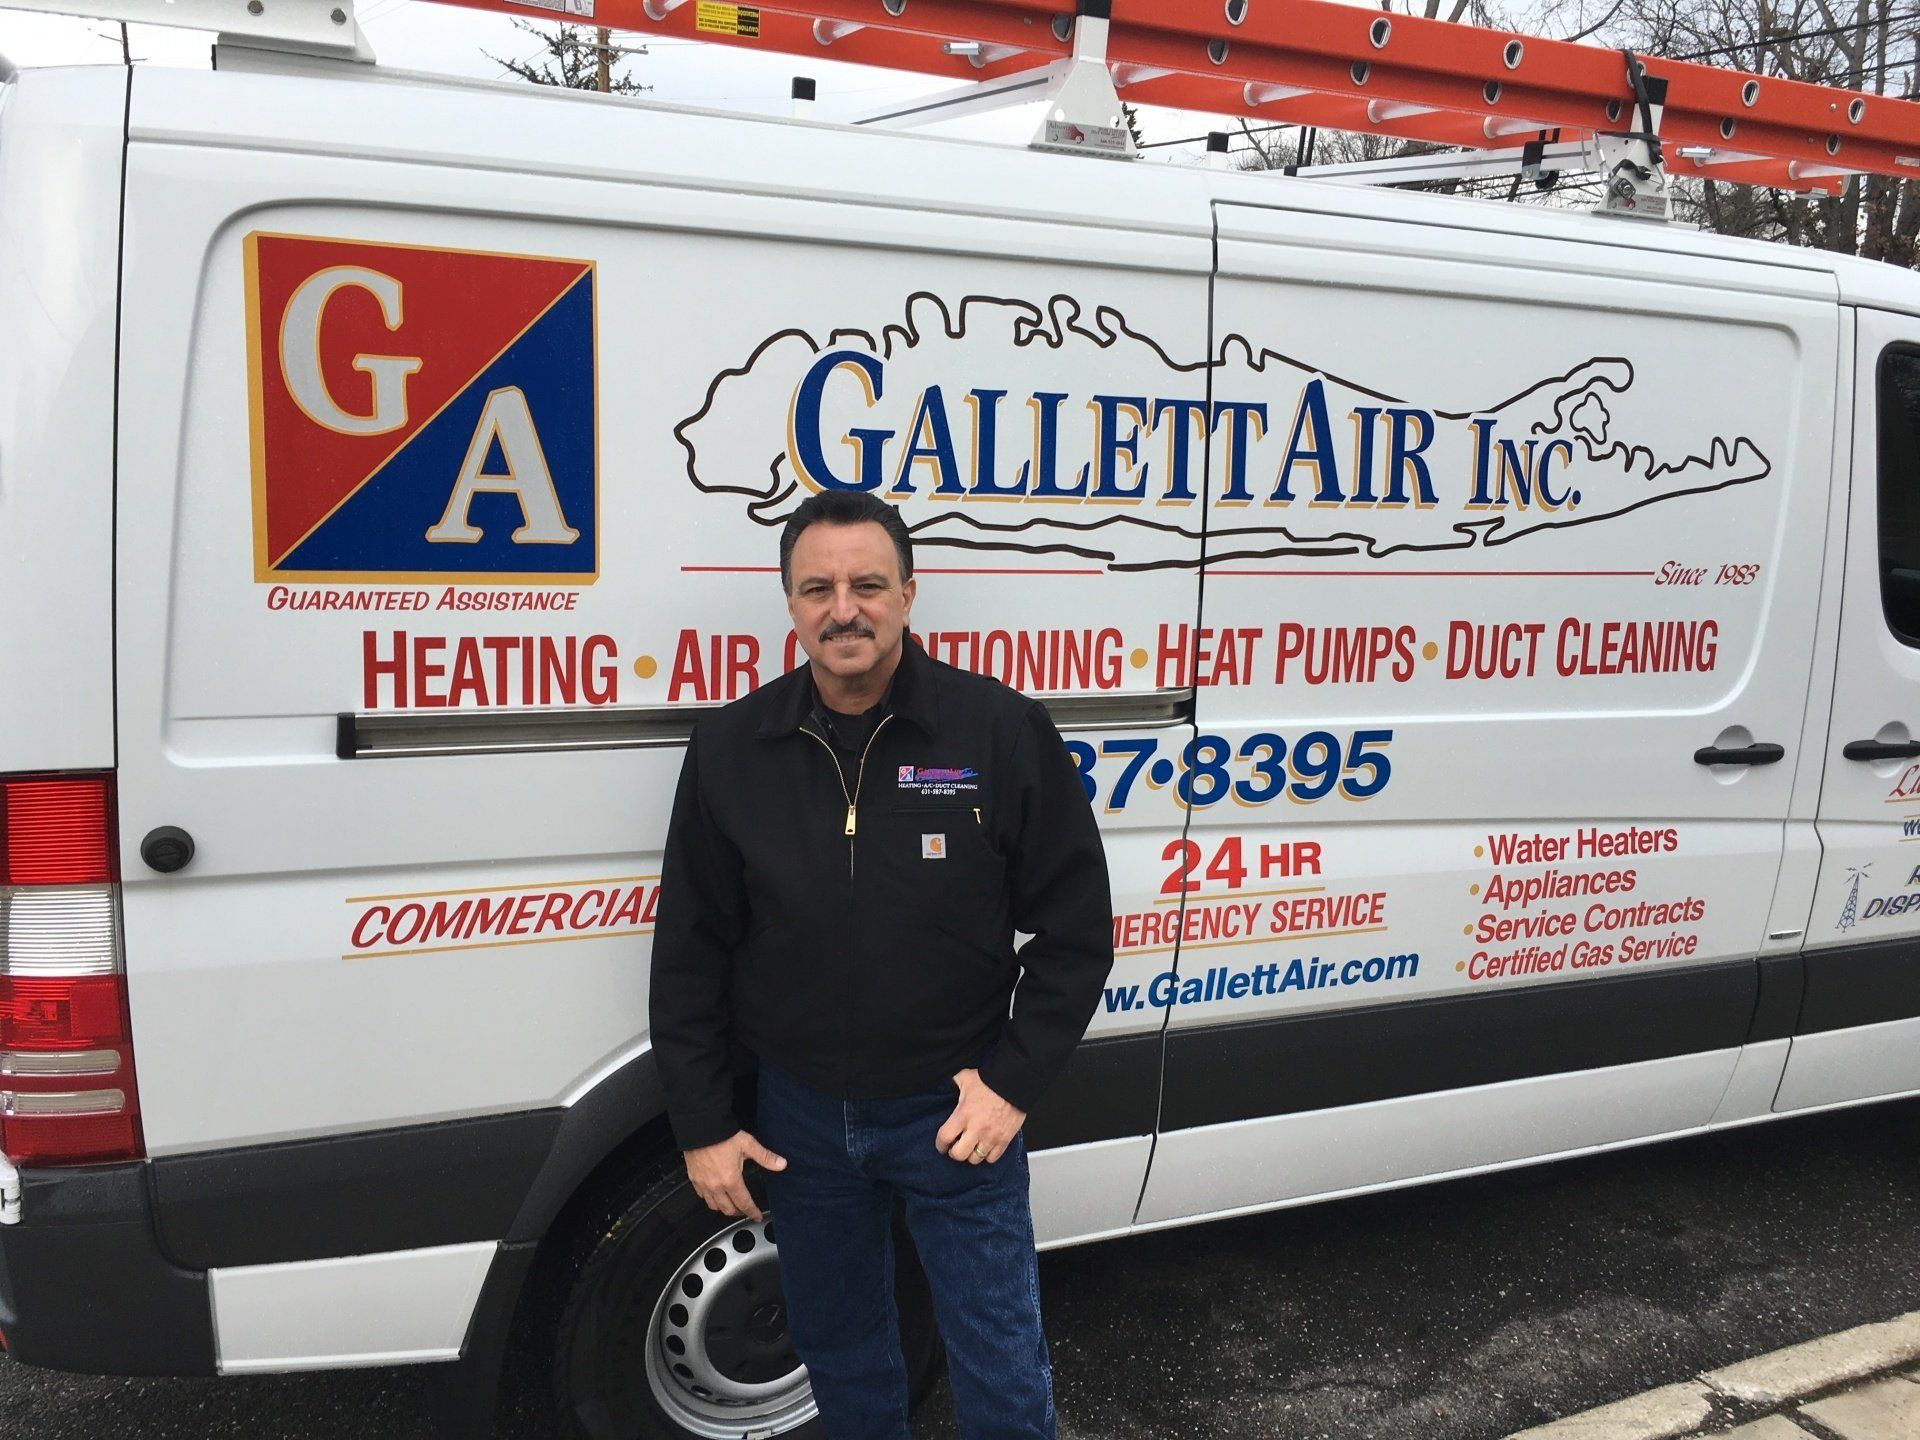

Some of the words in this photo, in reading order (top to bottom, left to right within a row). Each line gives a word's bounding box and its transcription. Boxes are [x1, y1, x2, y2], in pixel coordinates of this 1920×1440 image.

[279, 265, 423, 436] G
[787, 350, 1438, 511] GALLETTAIR
[1464, 417, 1582, 512] INC.
[425, 385, 580, 544] A
[267, 586, 430, 611] GUARANTEED
[436, 586, 580, 611] ASSISTANCE
[1655, 560, 1708, 586] Since
[1714, 564, 1760, 586] 1983
[363, 630, 618, 708] HEATING
[667, 629, 760, 702] AIR
[1155, 623, 1263, 687] HEAT
[1275, 622, 1416, 685] PUMPS
[1445, 619, 1546, 680] DUCT
[1556, 616, 1719, 677] CLEANING
[1160, 836, 1247, 894] 24
[1260, 841, 1321, 878] HR
[1488, 833, 1570, 865] Water
[1577, 826, 1678, 858] Heaters
[1482, 869, 1636, 910] Appliances
[1113, 903, 1262, 949] ERGENCY
[1270, 892, 1387, 934] SERVICE
[1475, 909, 1576, 943] Service
[1583, 896, 1705, 932] Contracts
[1468, 943, 1567, 981] Certified
[1571, 940, 1613, 969] Gas
[1618, 931, 1698, 963] Service
